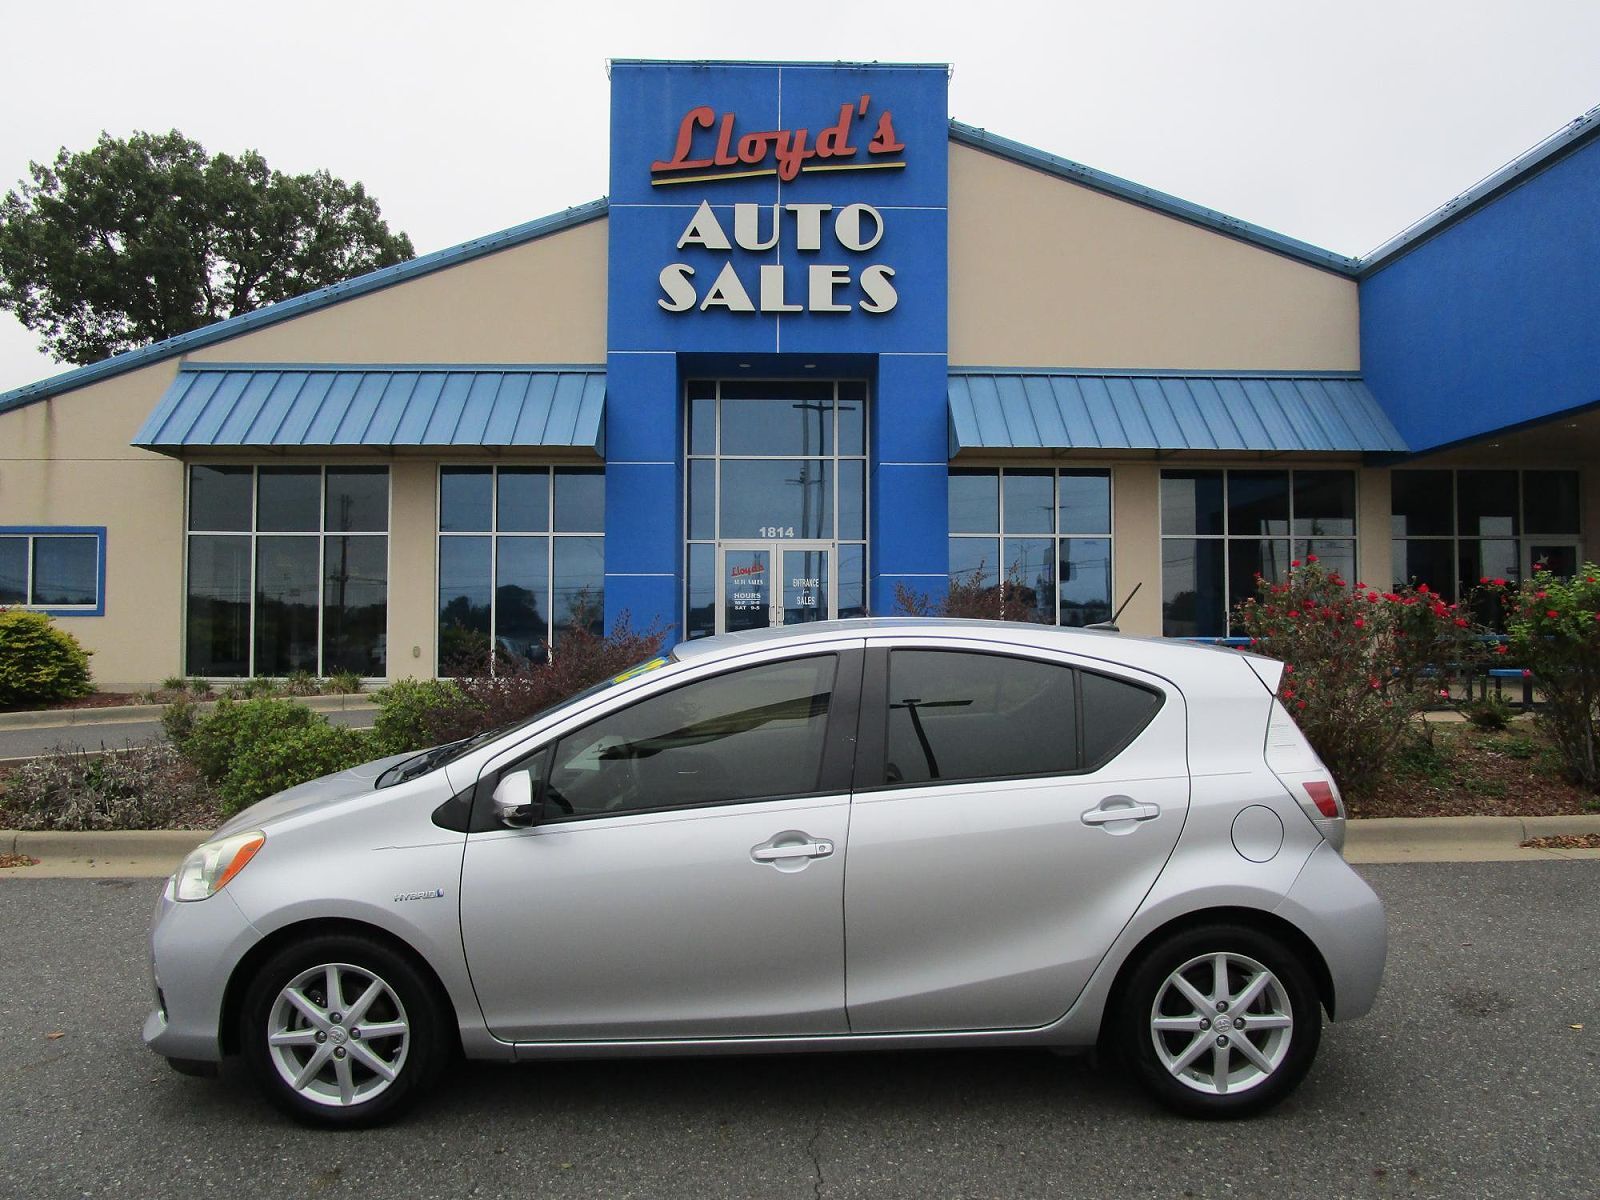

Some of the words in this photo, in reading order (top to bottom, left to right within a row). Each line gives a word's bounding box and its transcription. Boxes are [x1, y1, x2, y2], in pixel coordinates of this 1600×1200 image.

[651, 94, 905, 182] Lloyd's
[676, 200, 884, 251] AUTO
[657, 261, 898, 313] SALES
[759, 526, 794, 538] 1814
[793, 578, 819, 588] ENTRANCE
[797, 596, 815, 605] SALES
[394, 890, 436, 902] HYBRID
